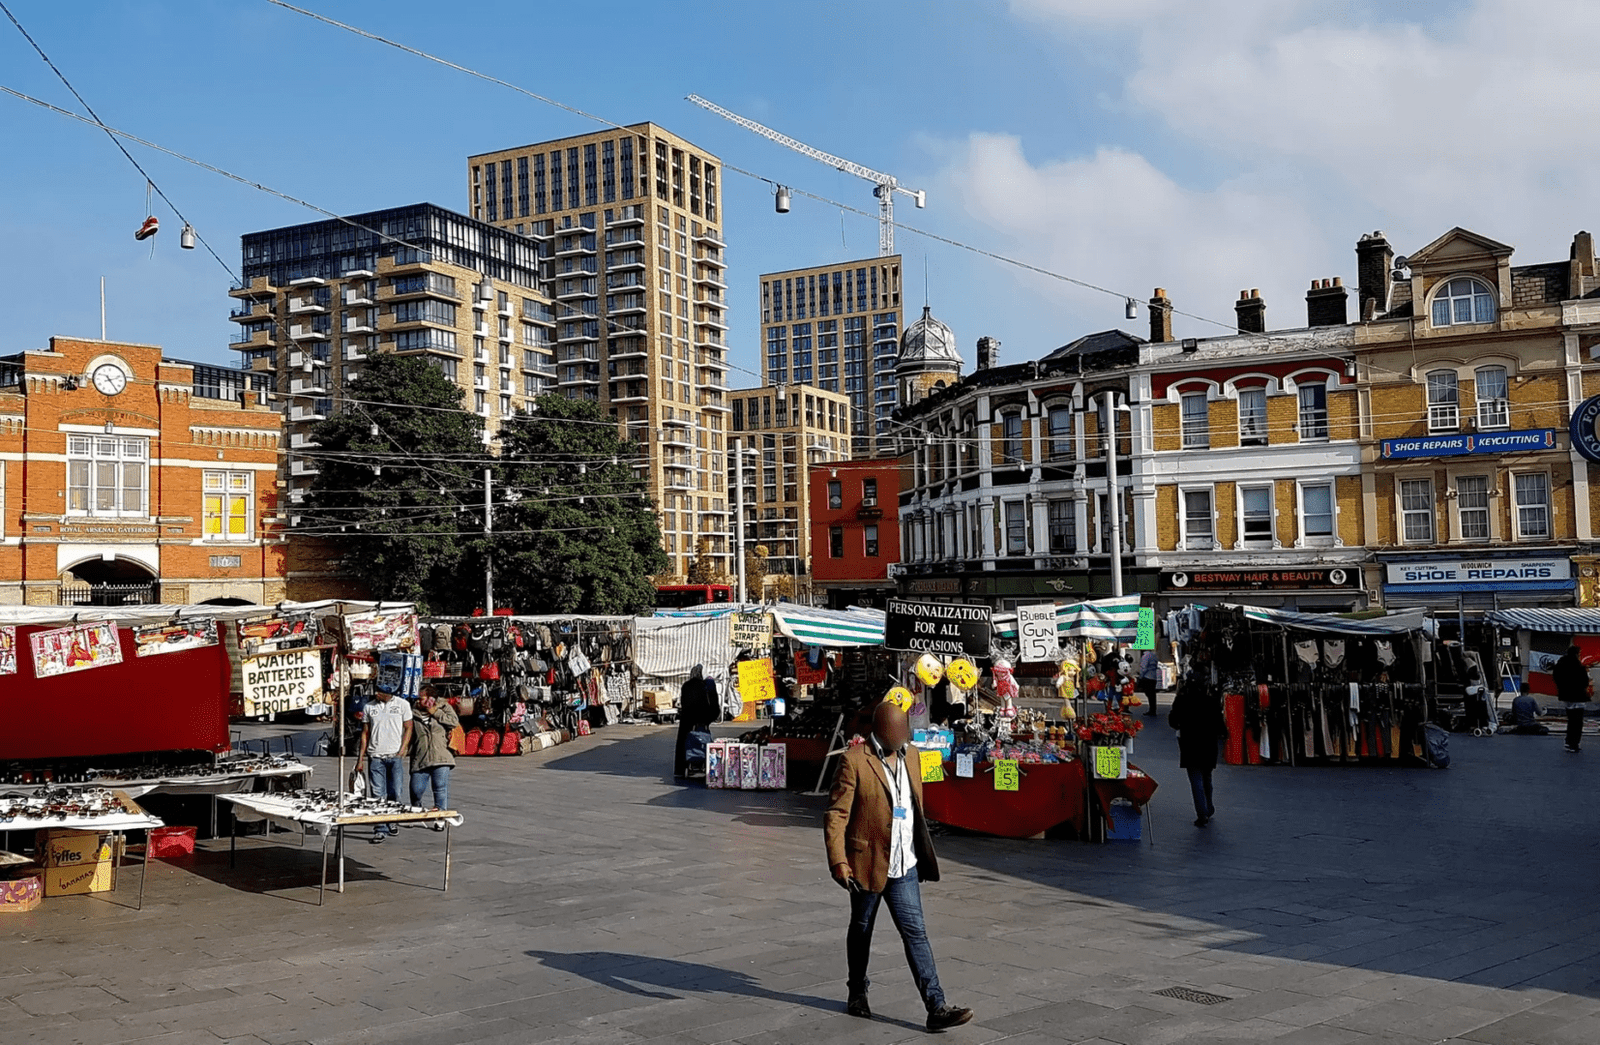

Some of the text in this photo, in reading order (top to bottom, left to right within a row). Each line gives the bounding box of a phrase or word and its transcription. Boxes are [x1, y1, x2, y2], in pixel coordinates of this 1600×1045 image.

[1394, 435, 1540, 451] SHOE REPAIRS KEYCUTTING
[1194, 572, 1324, 582] BESTWAY HAIR & BEAUTY
[1405, 568, 1552, 581] SHOE REPAIRS
[739, 614, 762, 623] WATCH
[889, 602, 989, 621] PERSONALIZATION
[1020, 610, 1055, 621] BUBBLE
[734, 624, 770, 632] BATTERIES
[914, 621, 960, 636] FOR ALL
[1022, 622, 1054, 638] GUN
[734, 632, 760, 641] STRAPS
[910, 638, 963, 652] OCCASIONS
[257, 652, 304, 668] WATCH
[248, 666, 314, 684] BATTERIES
[252, 682, 304, 700] STRAPS
[254, 699, 290, 716] FROM
[61, 870, 94, 890] BANANAS
